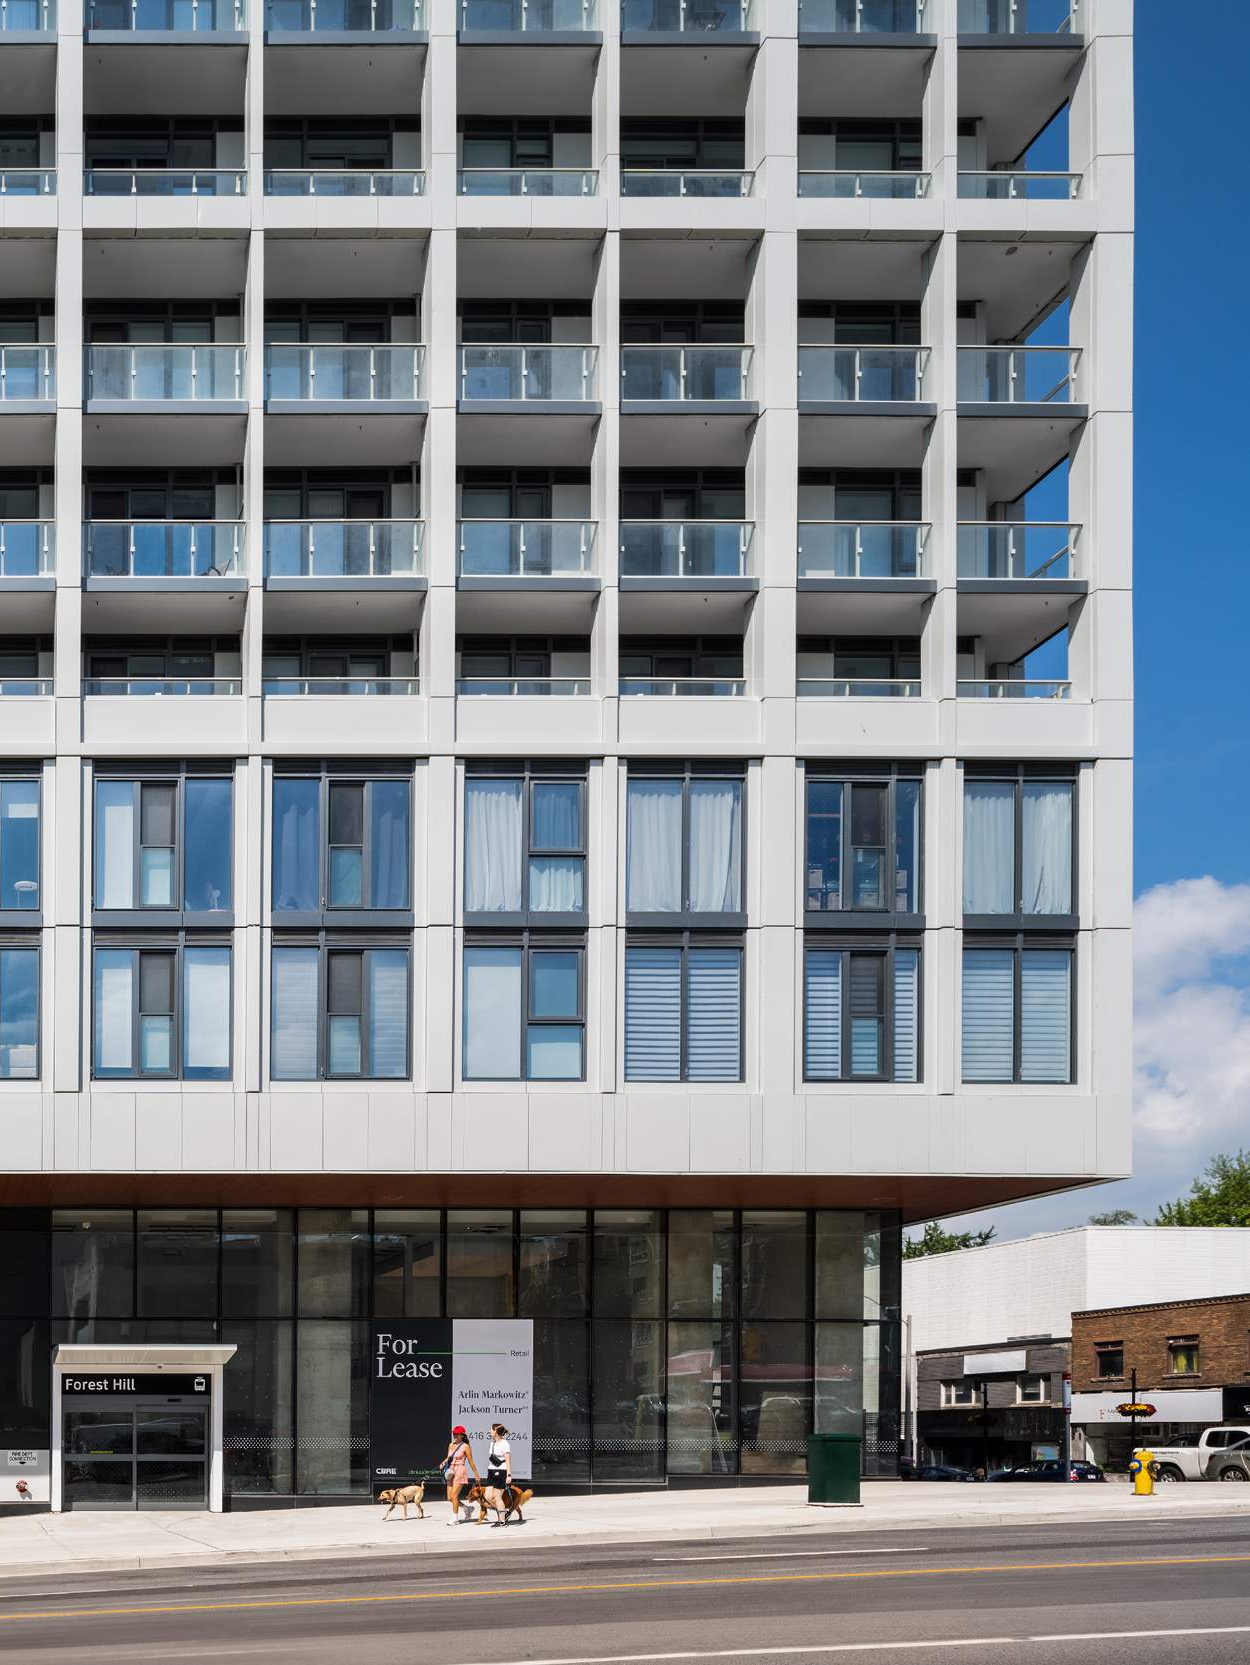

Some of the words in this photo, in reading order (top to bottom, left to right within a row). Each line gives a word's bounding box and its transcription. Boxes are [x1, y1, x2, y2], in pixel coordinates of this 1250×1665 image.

[376, 1334, 418, 1355] For
[510, 1349, 530, 1357] Retail
[376, 1357, 443, 1378] Lease
[65, 1379, 109, 1391] Forest
[113, 1378, 136, 1391] Hill
[458, 1390, 479, 1399] Arlin
[458, 1405, 491, 1415] Jackson
[375, 1467, 397, 1475] CBRE
